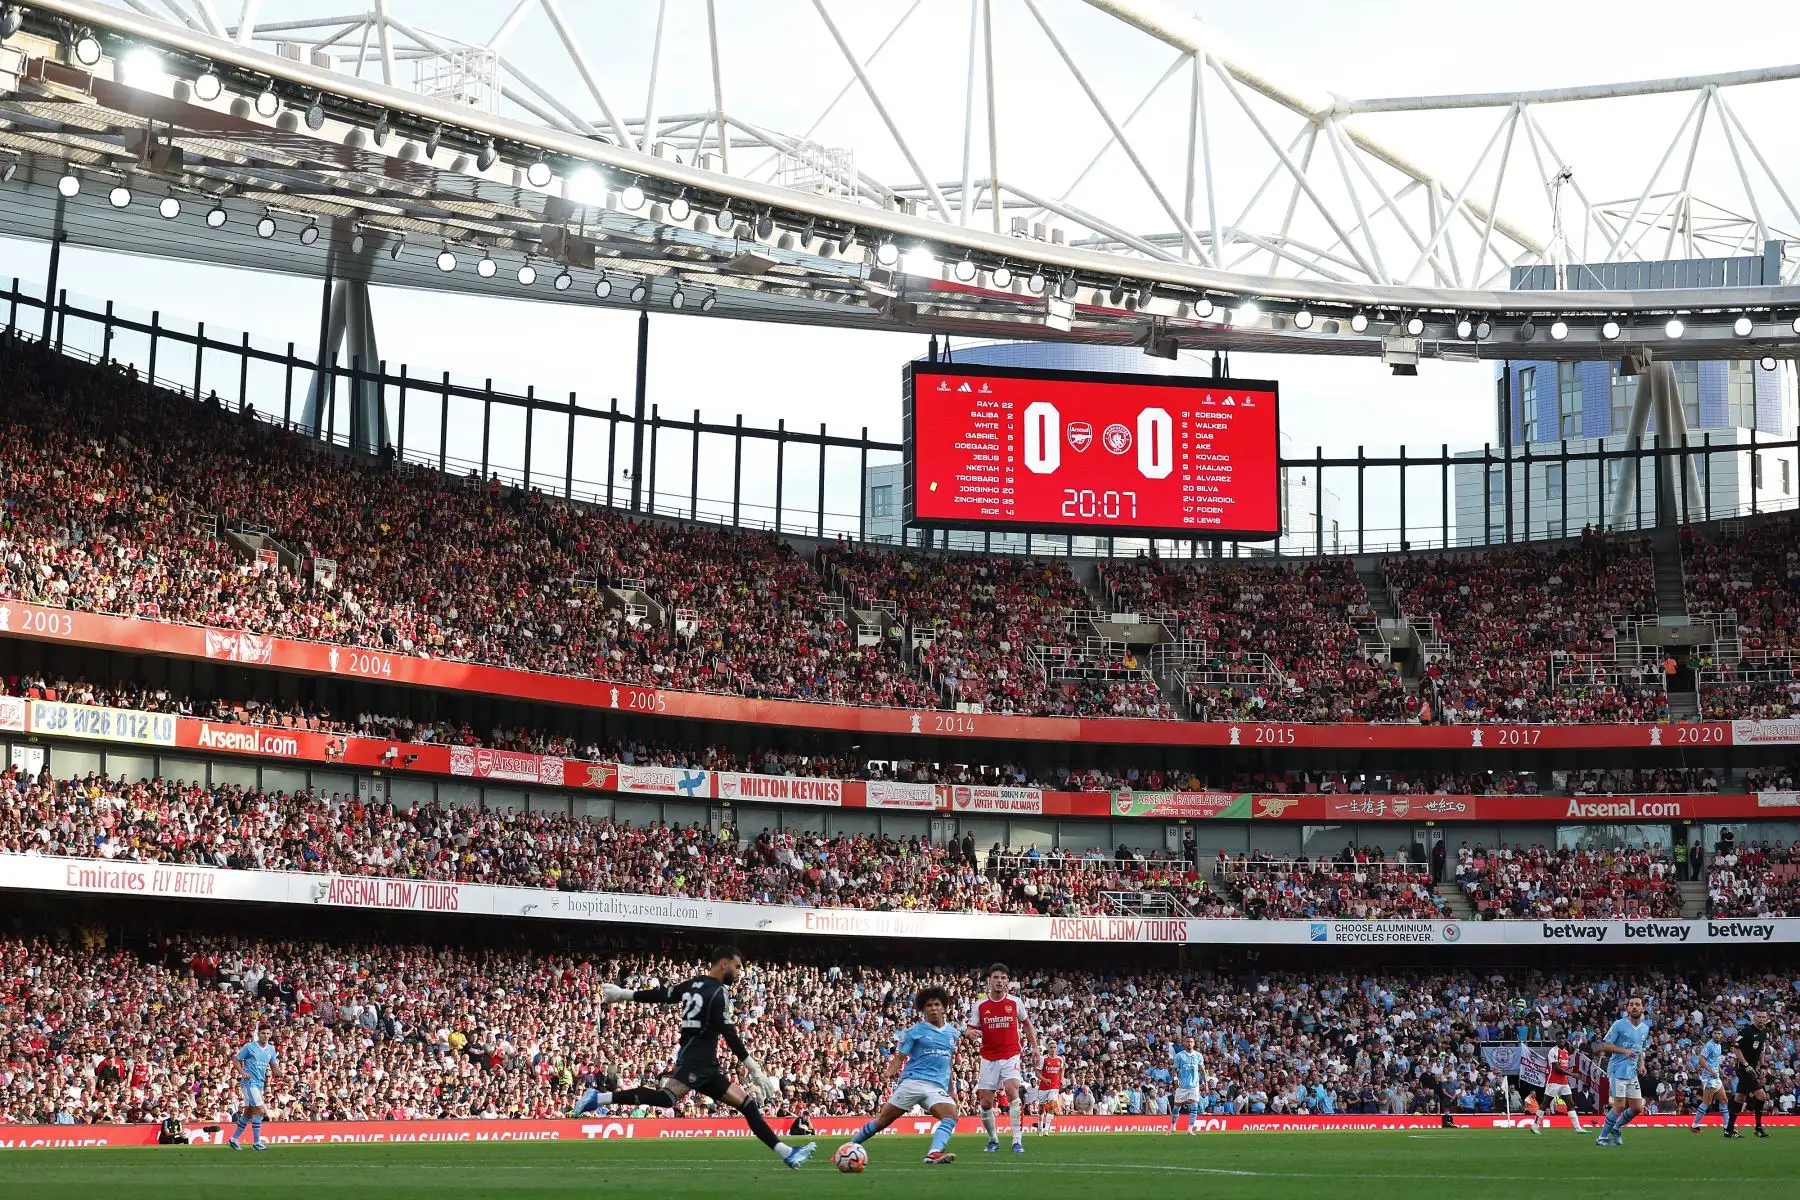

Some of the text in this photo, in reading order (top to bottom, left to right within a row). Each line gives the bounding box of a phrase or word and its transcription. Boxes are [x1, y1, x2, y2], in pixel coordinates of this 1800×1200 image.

[1195, 412, 1233, 420] EDERSON
[974, 422, 999, 430] WHITE
[1195, 422, 1228, 430] WALKER
[965, 432, 999, 440] GABRIEL
[1024, 401, 1061, 475] 0
[1136, 407, 1173, 479] 0
[954, 442, 1000, 451] ODEGAARD
[972, 454, 1000, 462] JESUS
[966, 464, 1000, 472] NKETIAH
[1196, 464, 1233, 472] HAALAND
[955, 475, 1000, 483] TROSSARD
[959, 486, 1000, 494] JORGINHO
[954, 496, 1000, 504] ZINCHENKO
[1062, 488, 1136, 519] 20:07
[1196, 496, 1236, 504] GVARDIOL
[21, 608, 73, 636] 2003
[350, 653, 392, 676] 2004
[629, 690, 666, 712] 2005
[34, 703, 68, 730] P38
[73, 707, 111, 736] W26
[935, 716, 975, 733] 2014
[198, 724, 298, 755] Arsenal.com
[1255, 728, 1295, 744] 2015
[1499, 730, 1541, 745] 2017
[1678, 727, 1723, 743] 2020
[492, 752, 539, 775] Arsenal
[633, 767, 676, 785] Arsenal
[740, 777, 839, 802] MILTON KEYNES
[885, 784, 934, 801] Arsenal
[974, 789, 1000, 798] ARSENAL
[974, 800, 1040, 811] WITH YOU ALWAYS
[1138, 794, 1233, 807] ARSENAL BANGLADESH
[1335, 798, 1388, 817] 一生槍手
[1566, 799, 1680, 818] Arsenal.com
[66, 863, 215, 895] Emirates FLY BETTER
[327, 878, 459, 912] ARSENAL.COM/TOURS
[567, 895, 700, 922] hospitality.arsenal.com
[805, 912, 870, 932] Emirates
[1050, 918, 1187, 942] ARSENAL.COM/TOURS
[1334, 924, 1435, 932] CHOOSE ALUMINIUM.
[1336, 934, 1434, 942] RECYCLES FOREVER.
[1543, 923, 1608, 942] betway
[1624, 922, 1691, 942] betway
[1708, 922, 1774, 941] betway
[682, 992, 704, 1028] 22
[984, 1016, 1014, 1024] Emirates
